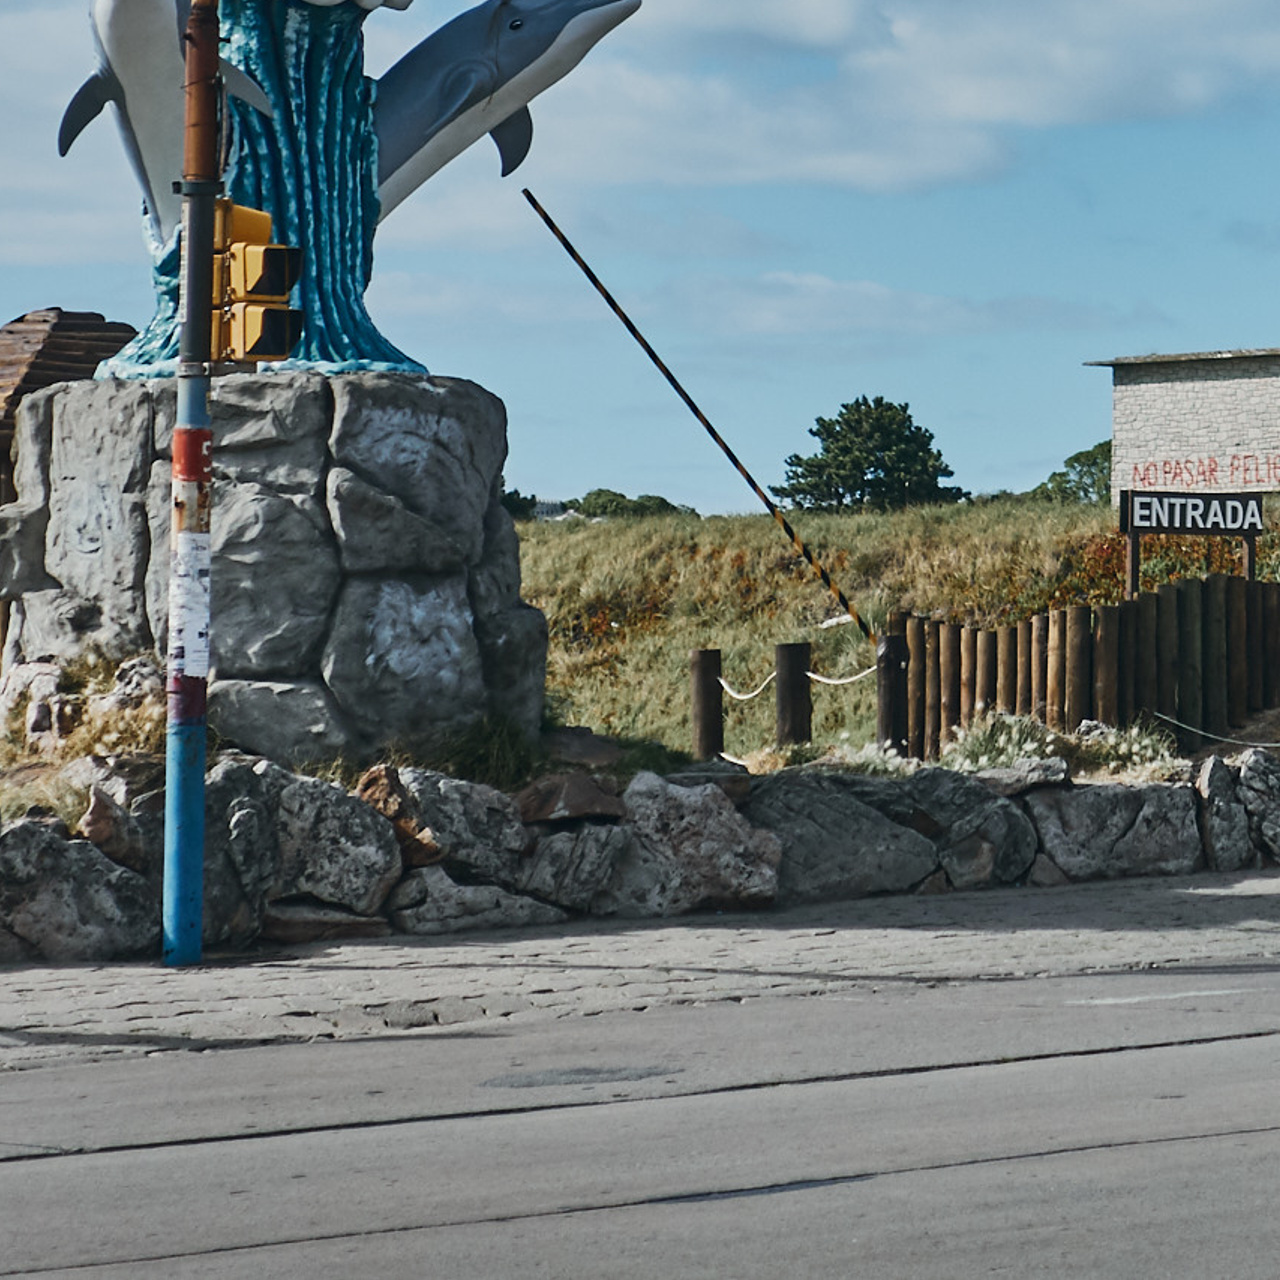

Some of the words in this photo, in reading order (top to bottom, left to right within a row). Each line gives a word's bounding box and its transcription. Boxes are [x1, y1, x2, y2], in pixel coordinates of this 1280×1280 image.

[1132, 462, 1158, 488] NO
[1162, 457, 1219, 487] PASAR
[1133, 496, 1263, 530] ENTRADA
